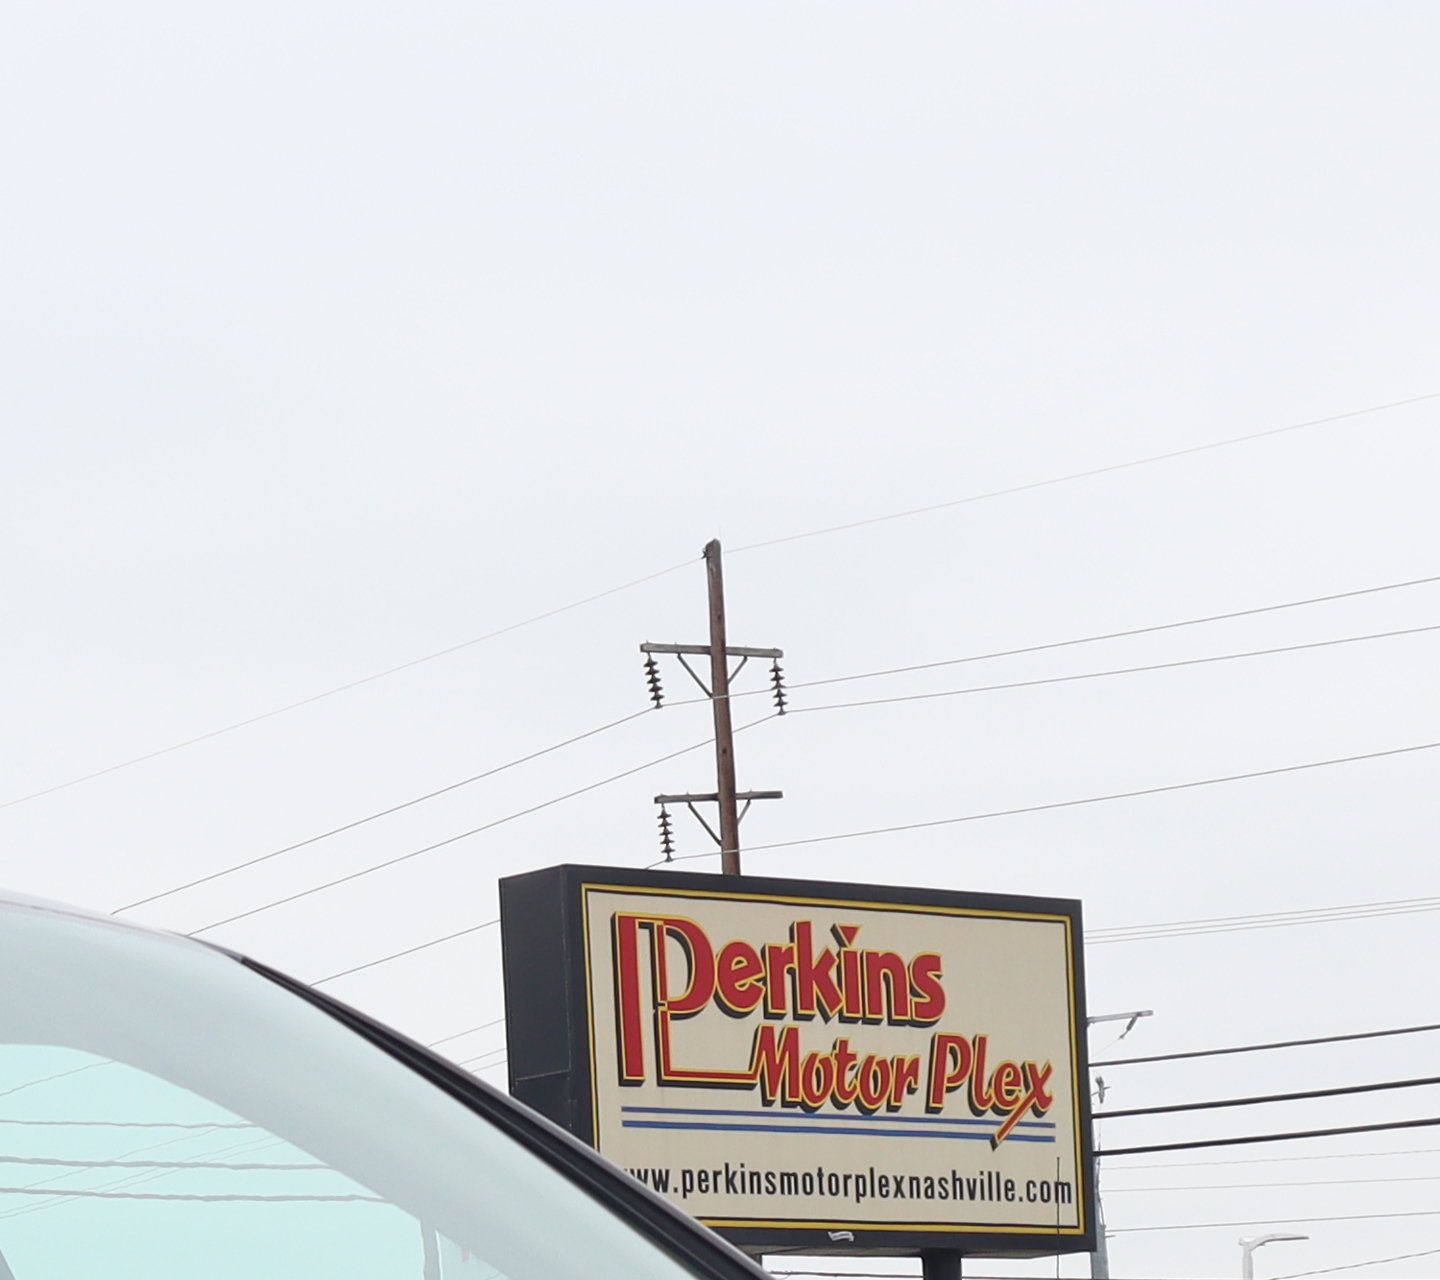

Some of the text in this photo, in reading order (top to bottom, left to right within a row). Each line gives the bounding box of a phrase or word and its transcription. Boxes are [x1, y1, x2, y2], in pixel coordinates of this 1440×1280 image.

[613, 913, 947, 1086] Perkins
[751, 1024, 1056, 1151] Motor Plex
[624, 1162, 1072, 1204] ww.perkinsmotorplexnashville.com
